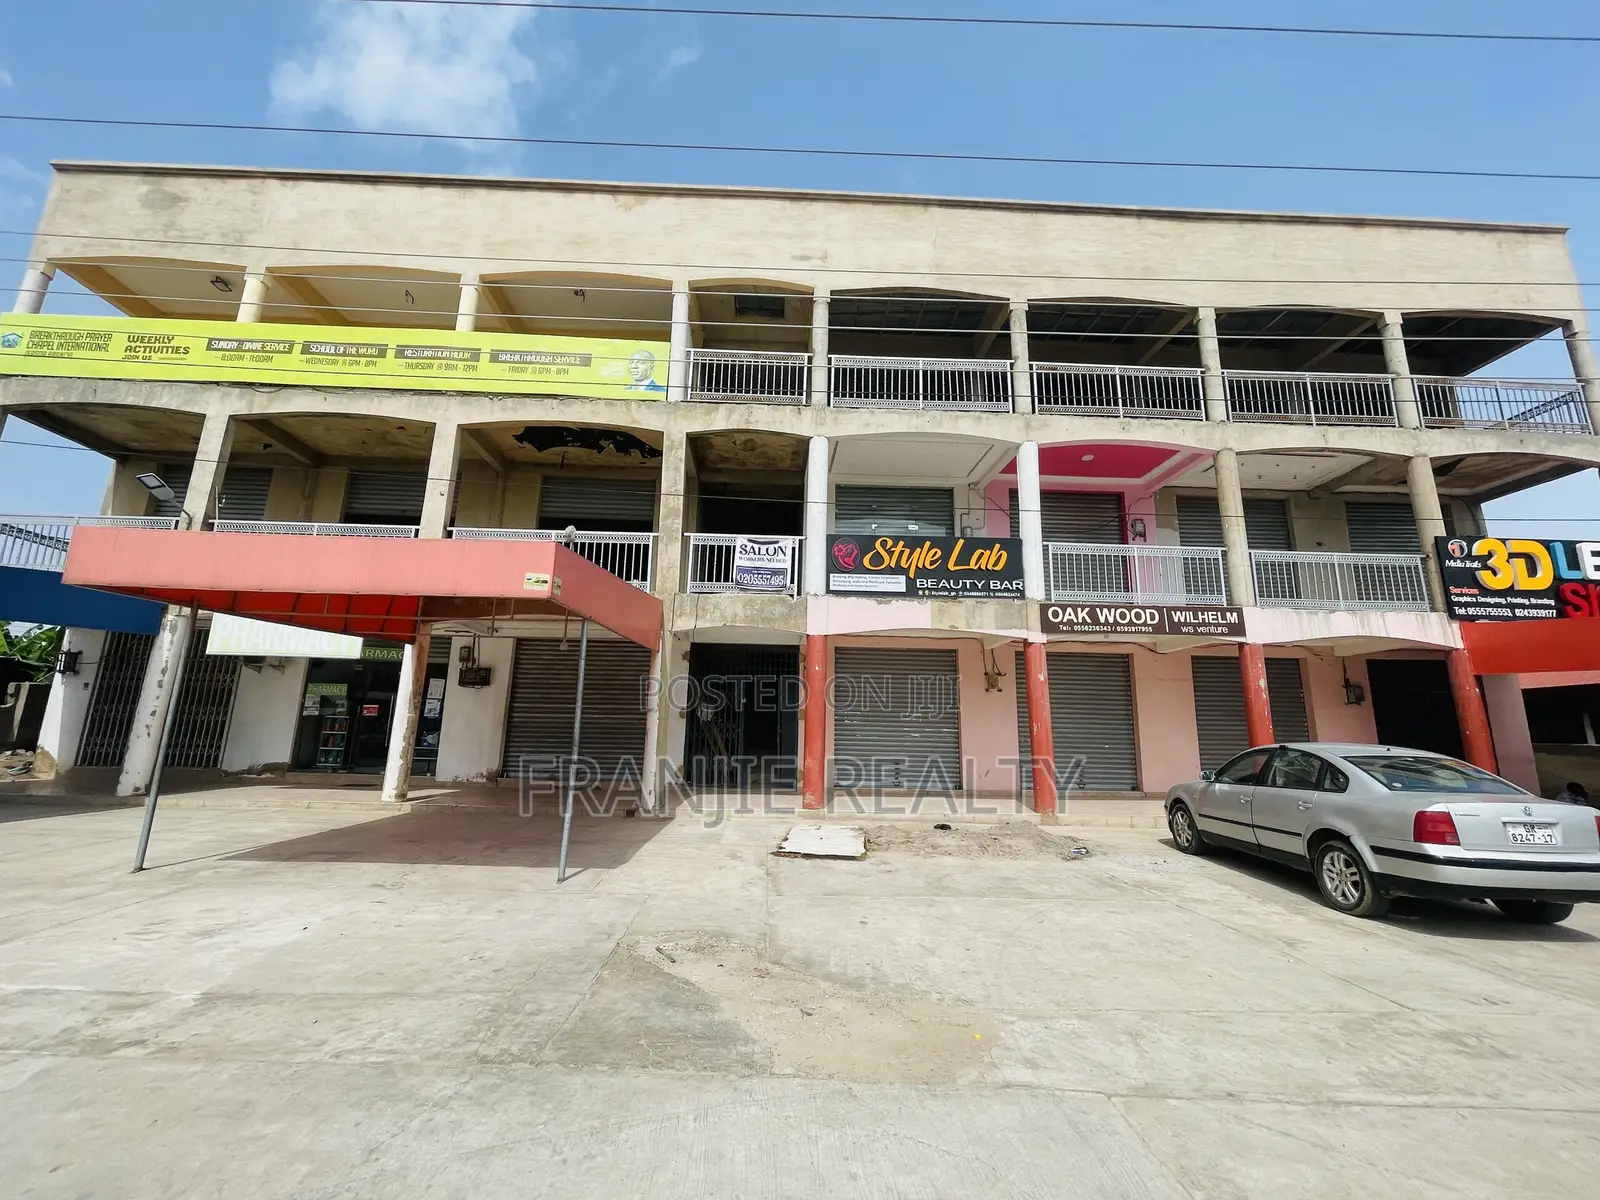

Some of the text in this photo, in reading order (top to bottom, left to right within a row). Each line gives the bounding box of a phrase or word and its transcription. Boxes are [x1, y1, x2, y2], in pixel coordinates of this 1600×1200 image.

[29, 330, 113, 342] BREAKTHROUGH PRAYER
[127, 335, 175, 344] WEEKLY
[26, 340, 110, 352] CHAPEL INTERNATIONAL
[124, 345, 191, 355] ACTIVITIES
[211, 340, 239, 349] SUNDAY
[242, 342, 264, 350] DIVINE
[264, 343, 291, 351] SERVICE
[309, 344, 336, 353] SCHOOL
[337, 346, 345, 354] OF
[305, 357, 340, 366] WEDNESDAY
[405, 362, 435, 370] THURSDAY
[508, 366, 529, 374] FRIDAY
[739, 544, 787, 557] SALON
[862, 536, 1008, 579] Style Lab
[1445, 559, 1465, 568] Media
[738, 573, 784, 585] 0205557495
[916, 579, 1024, 590] BEAUTY BAR
[1048, 606, 1159, 624] OAK WOOD
[1171, 611, 1239, 624] WILHELM
[1197, 625, 1228, 633] venture
[308, 684, 347, 694] PHARMACY
[1523, 824, 1537, 833] GR
